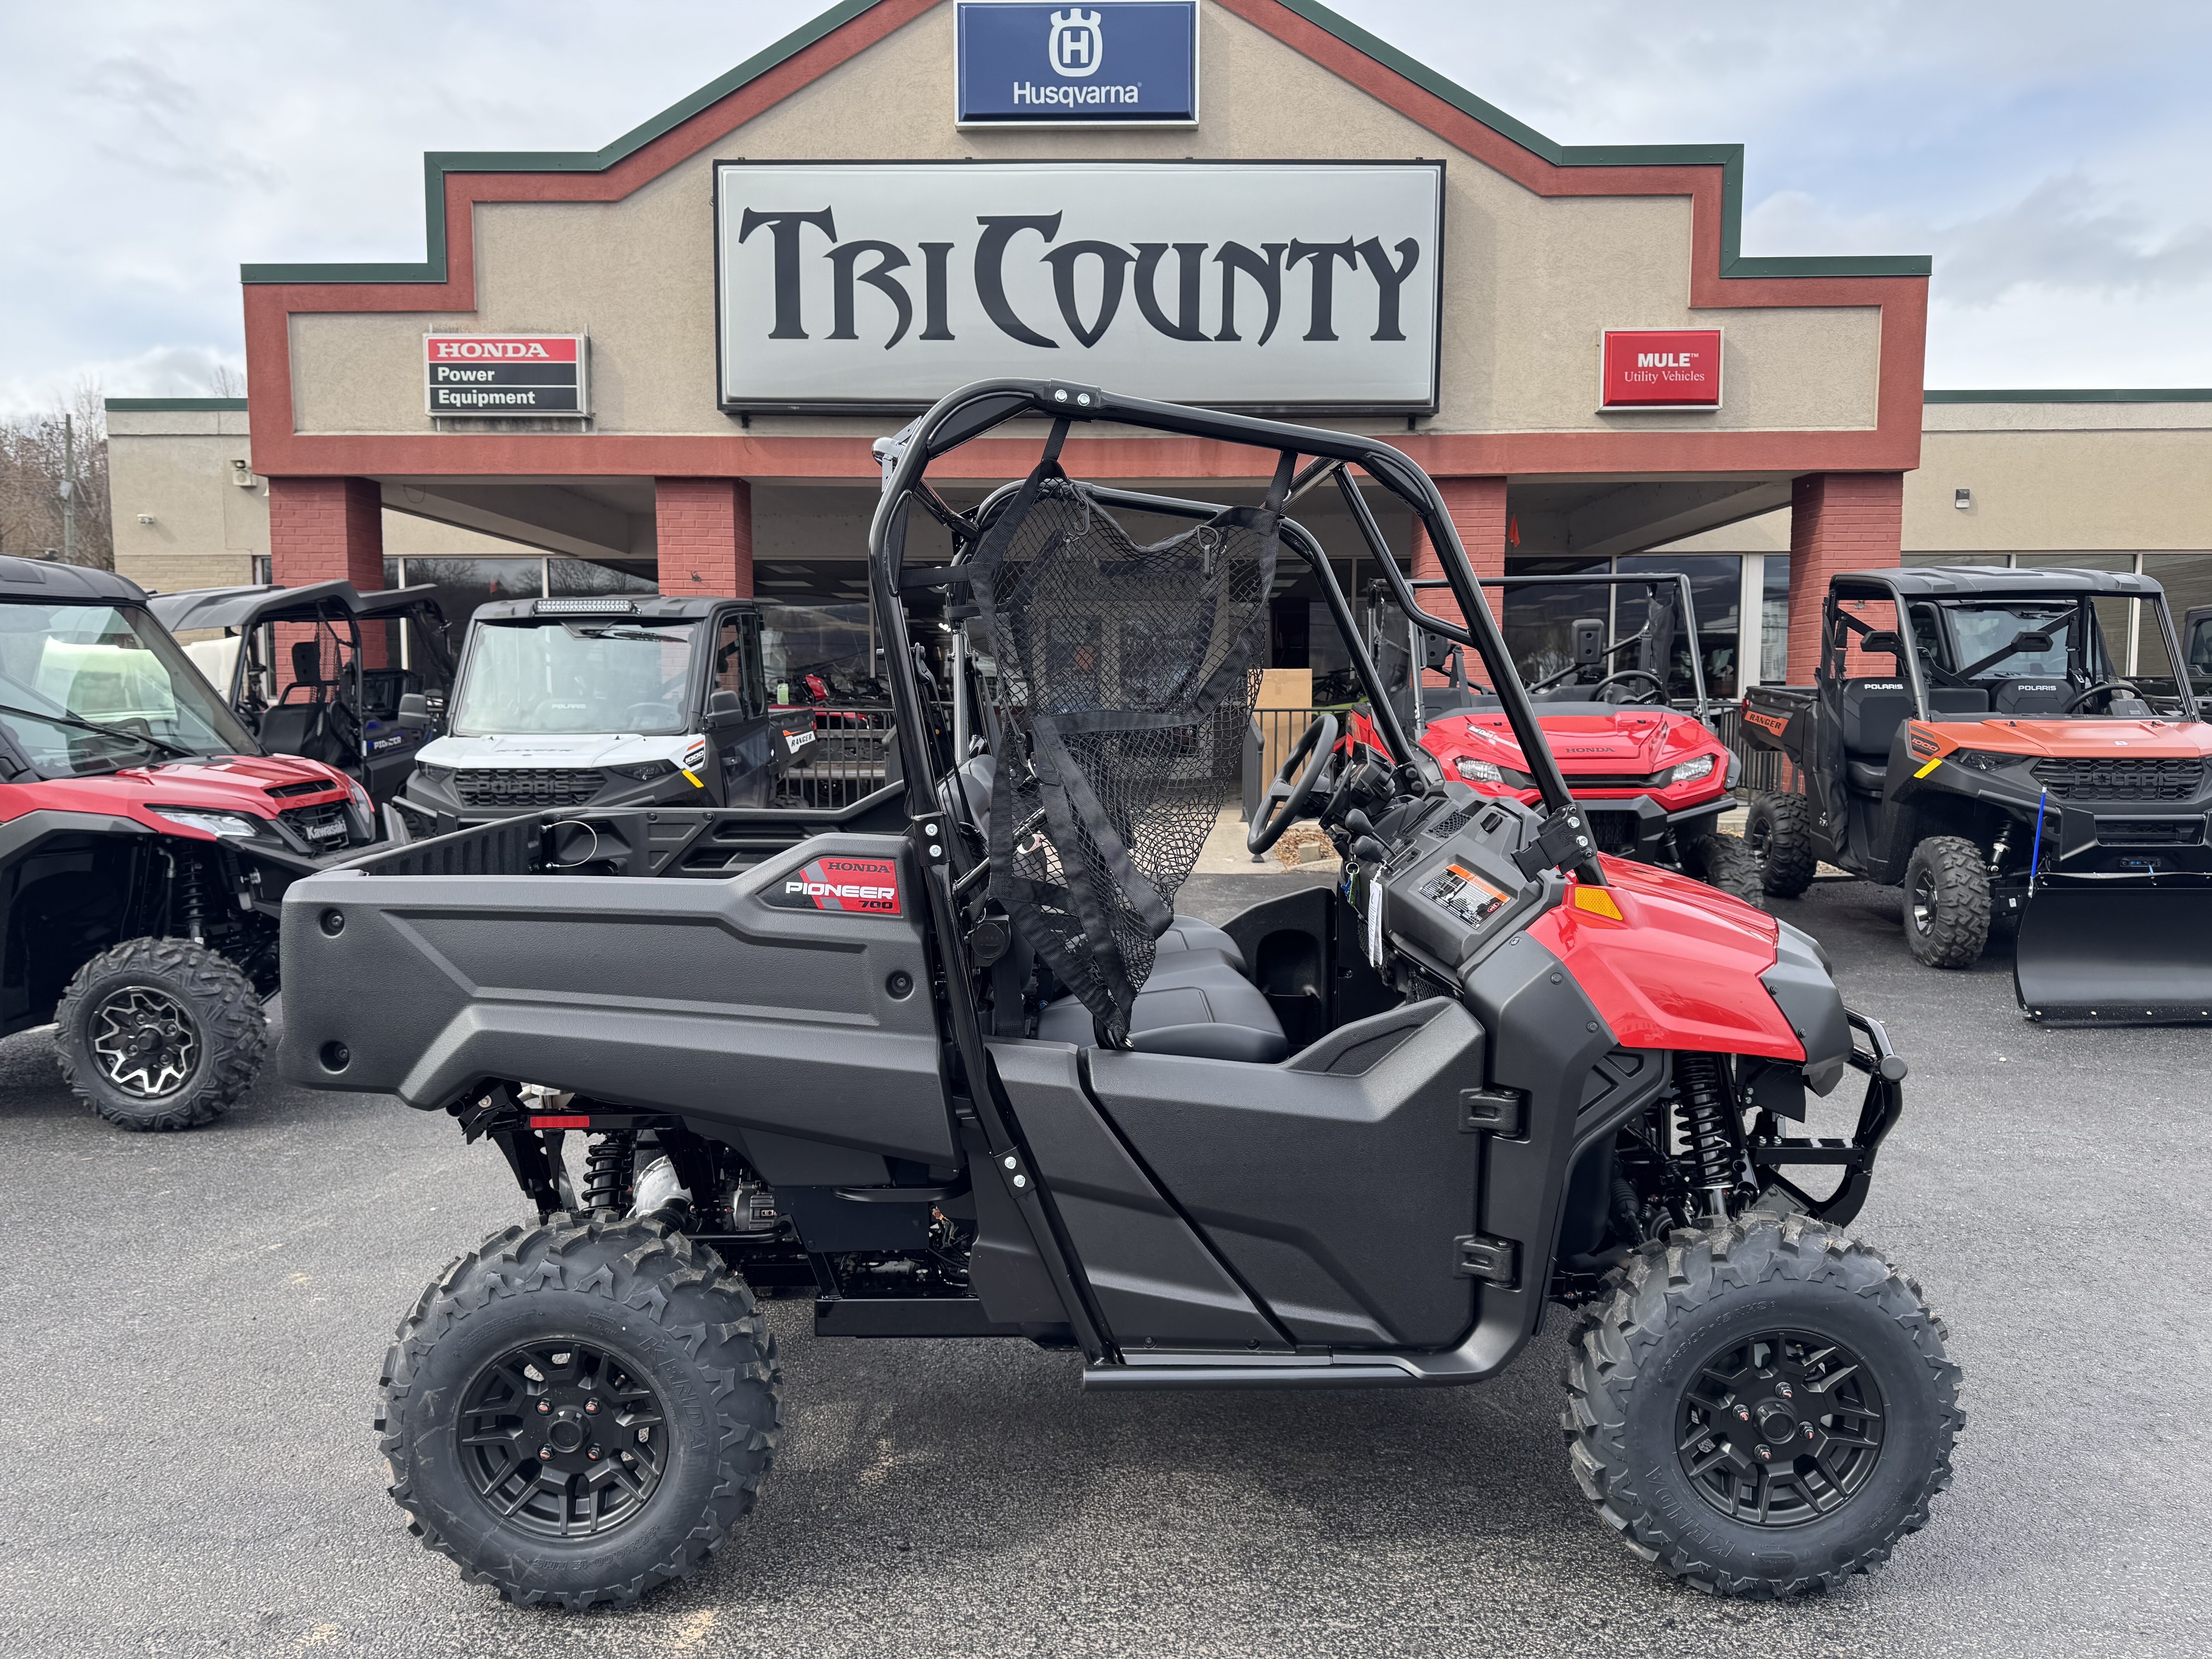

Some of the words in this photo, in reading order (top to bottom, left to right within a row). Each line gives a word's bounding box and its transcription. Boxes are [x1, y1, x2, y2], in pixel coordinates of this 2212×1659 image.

[1013, 81, 1139, 108] Husqvarna
[436, 343, 550, 357] HONDA
[438, 367, 495, 381] Power
[1625, 371, 1659, 384] Utility
[1661, 370, 1705, 381] Vehicles
[438, 389, 536, 407] Equipment
[1749, 714, 1782, 730] RANGER
[791, 733, 813, 747] RANGER
[1912, 738, 1939, 752] 1000
[685, 750, 704, 764] 1000
[2075, 772, 2181, 786] POLARIS
[476, 780, 570, 794] POLARIS
[306, 819, 347, 840] Kawasaki
[827, 862, 891, 873] HONDA
[785, 881, 895, 900] PIONEER
[858, 900, 893, 909] 700
[637, 1334, 708, 1451] KENDA
[1644, 1465, 1736, 1559] KENDA
